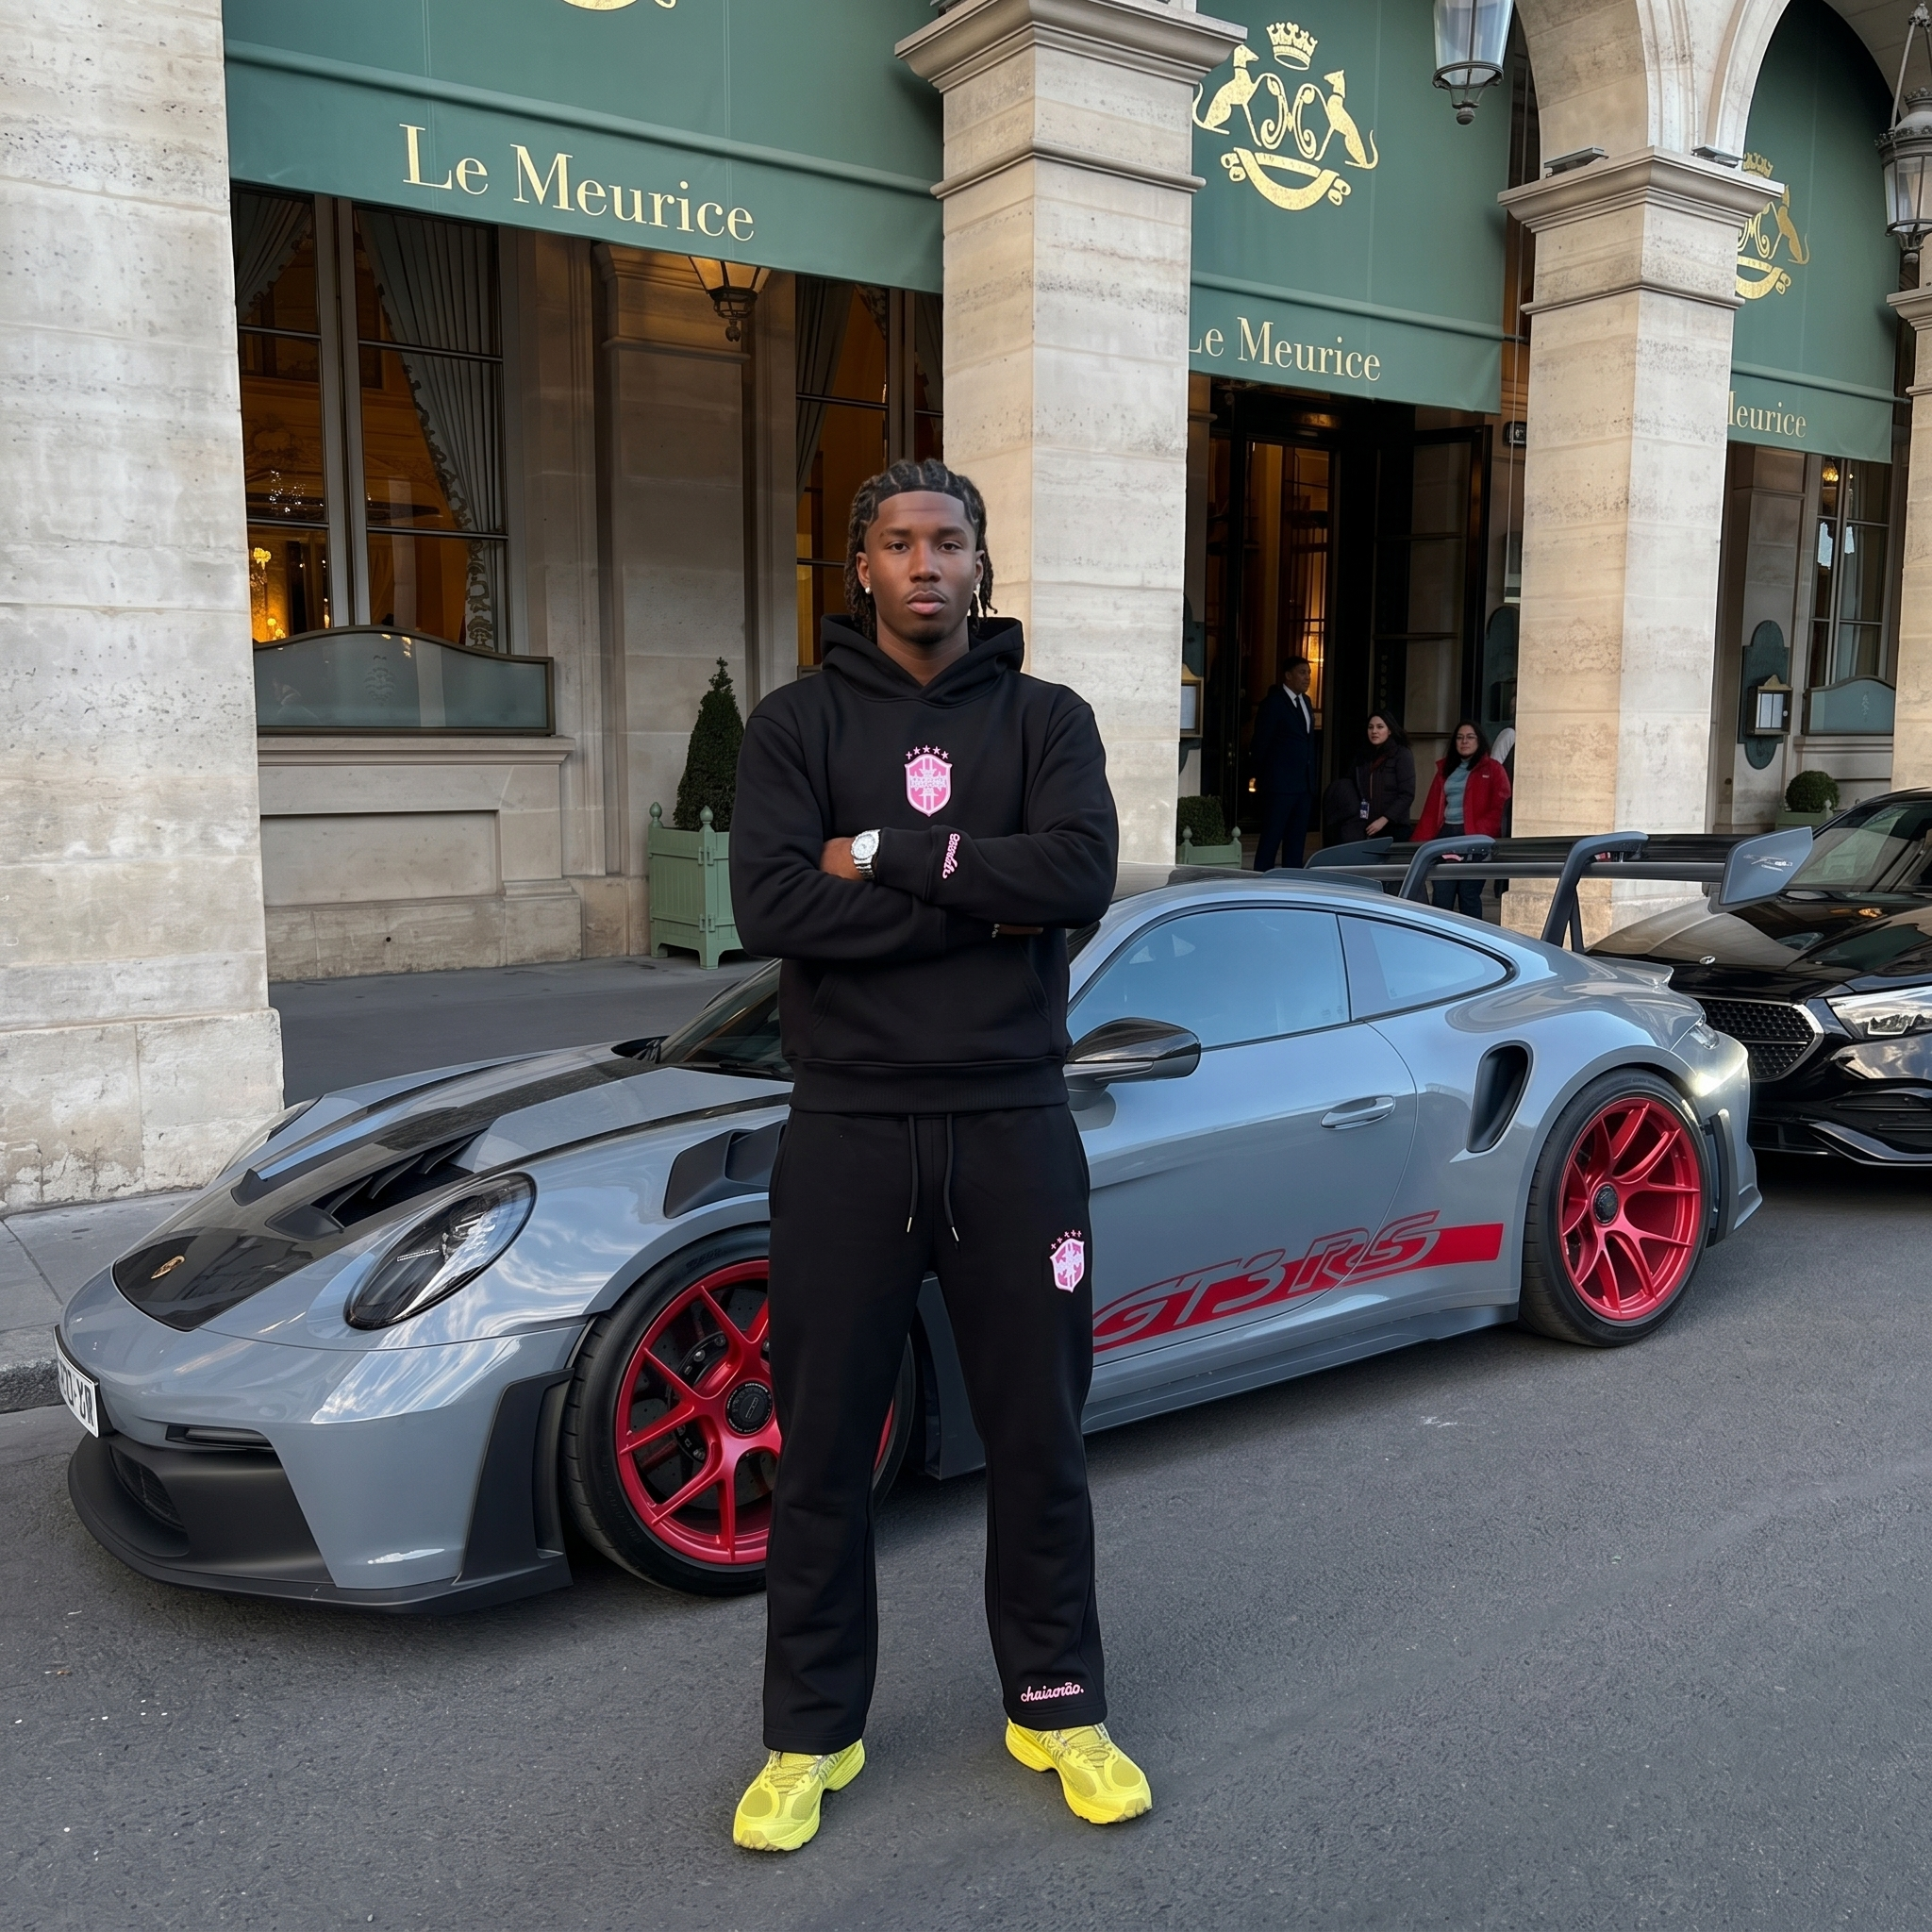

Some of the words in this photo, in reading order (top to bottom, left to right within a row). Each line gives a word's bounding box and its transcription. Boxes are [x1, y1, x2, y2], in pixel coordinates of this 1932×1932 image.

[399, 123, 488, 194] Le
[510, 143, 756, 242] Meurice
[1237, 316, 1382, 382] Meurice
